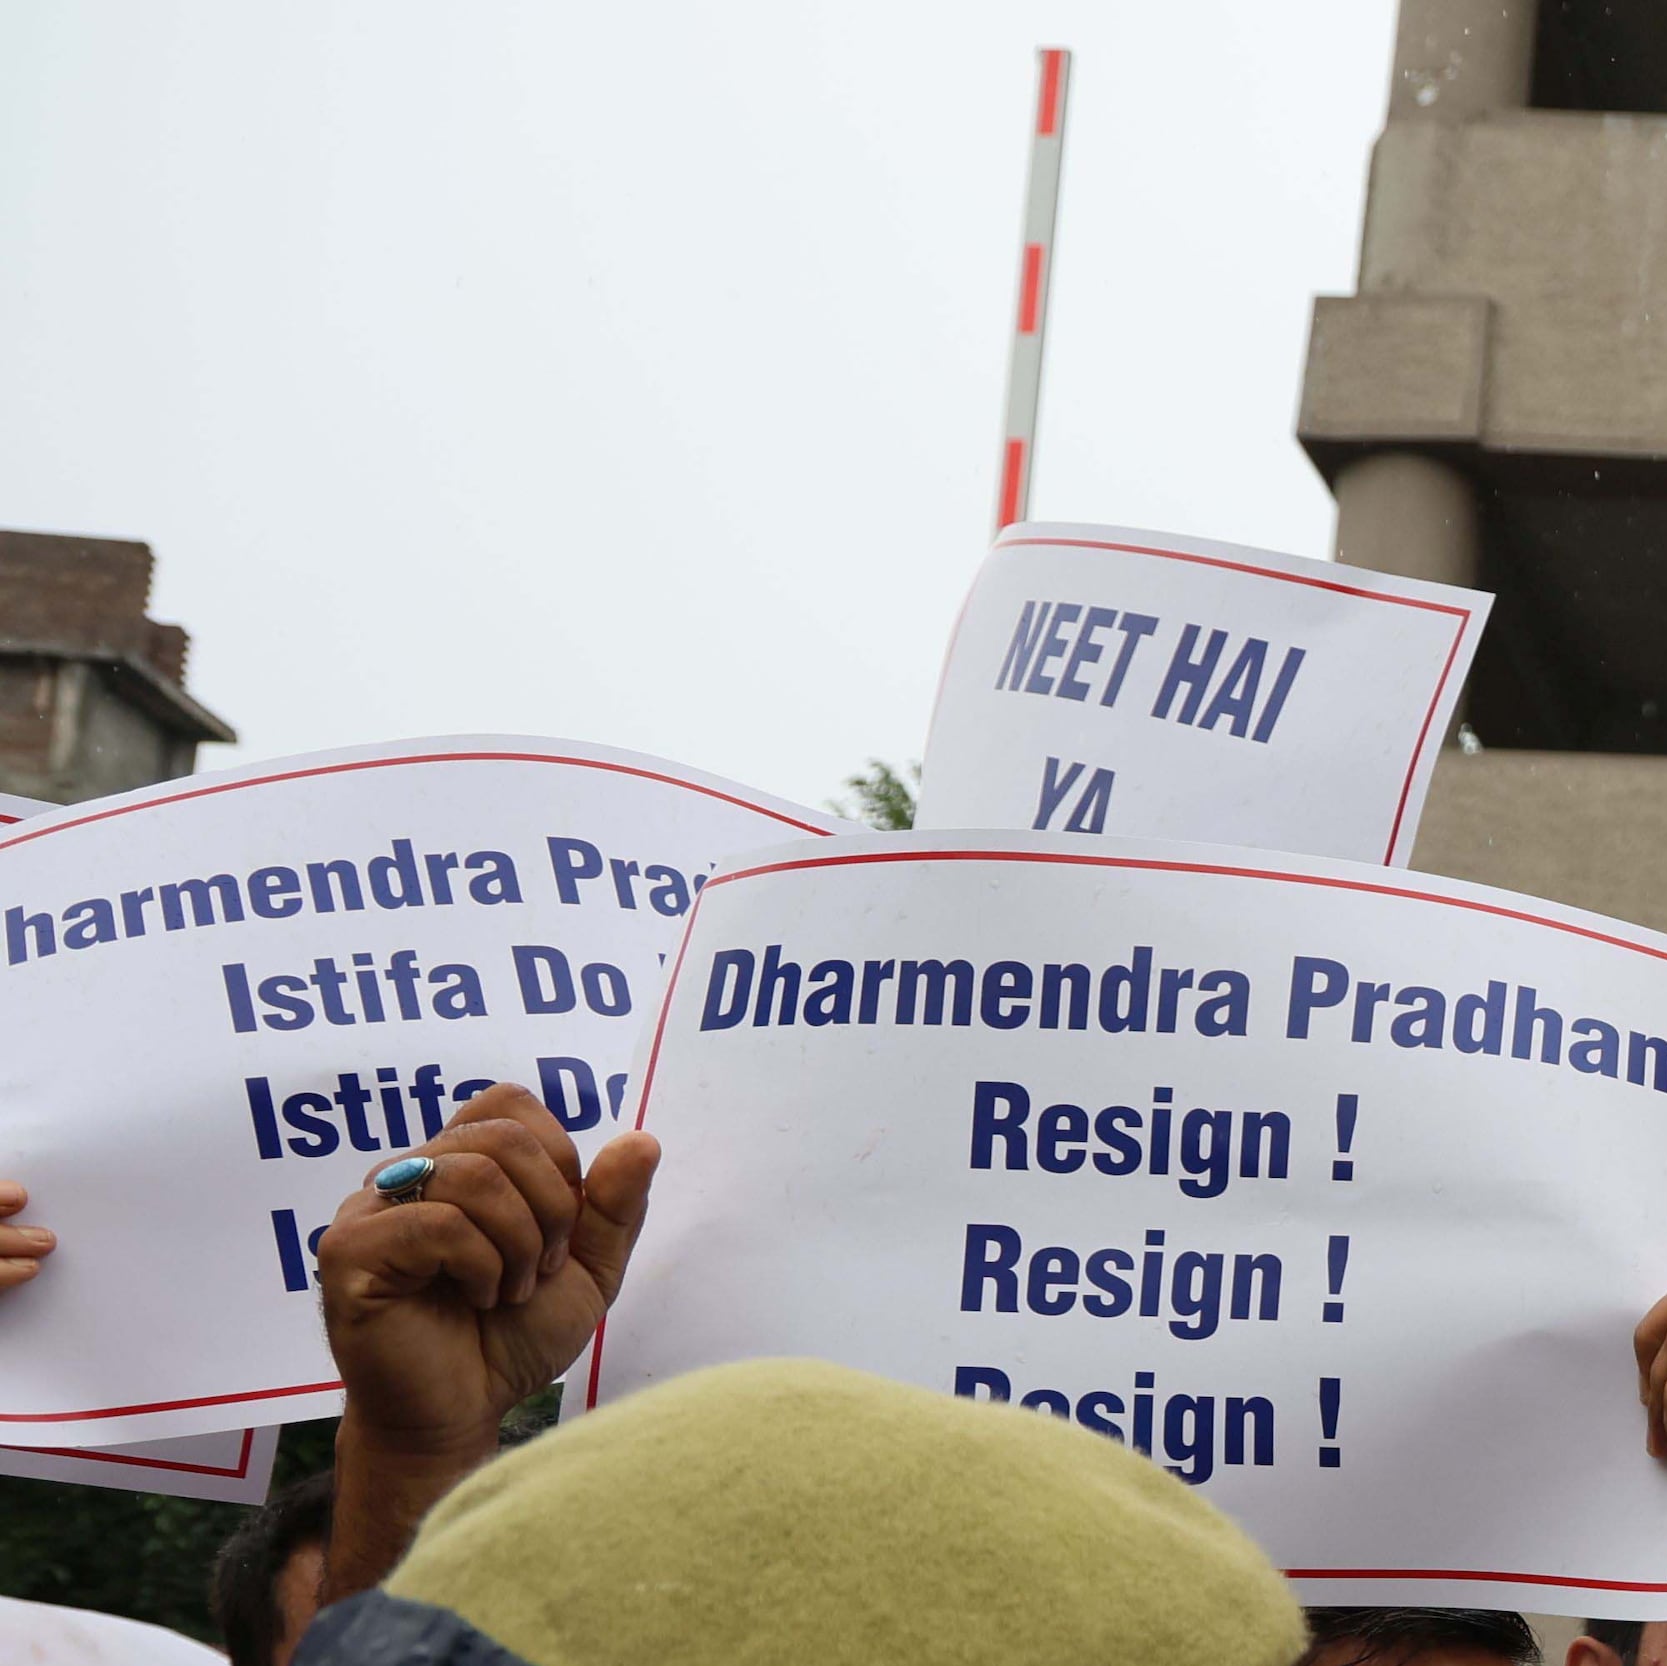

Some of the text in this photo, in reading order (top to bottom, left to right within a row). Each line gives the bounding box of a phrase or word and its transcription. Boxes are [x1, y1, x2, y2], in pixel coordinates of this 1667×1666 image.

[995, 600, 1306, 743] NEET HAI
[1033, 757, 1115, 834] YA
[5, 838, 524, 966] harmendra
[222, 945, 633, 1033] Istifa Do
[702, 943, 1251, 1038] Dharmendra
[246, 1064, 497, 1160] Istif
[971, 1081, 1360, 1200] Resign !
[961, 1223, 1352, 1341] Resign !
[1319, 1376, 1342, 1468] !
